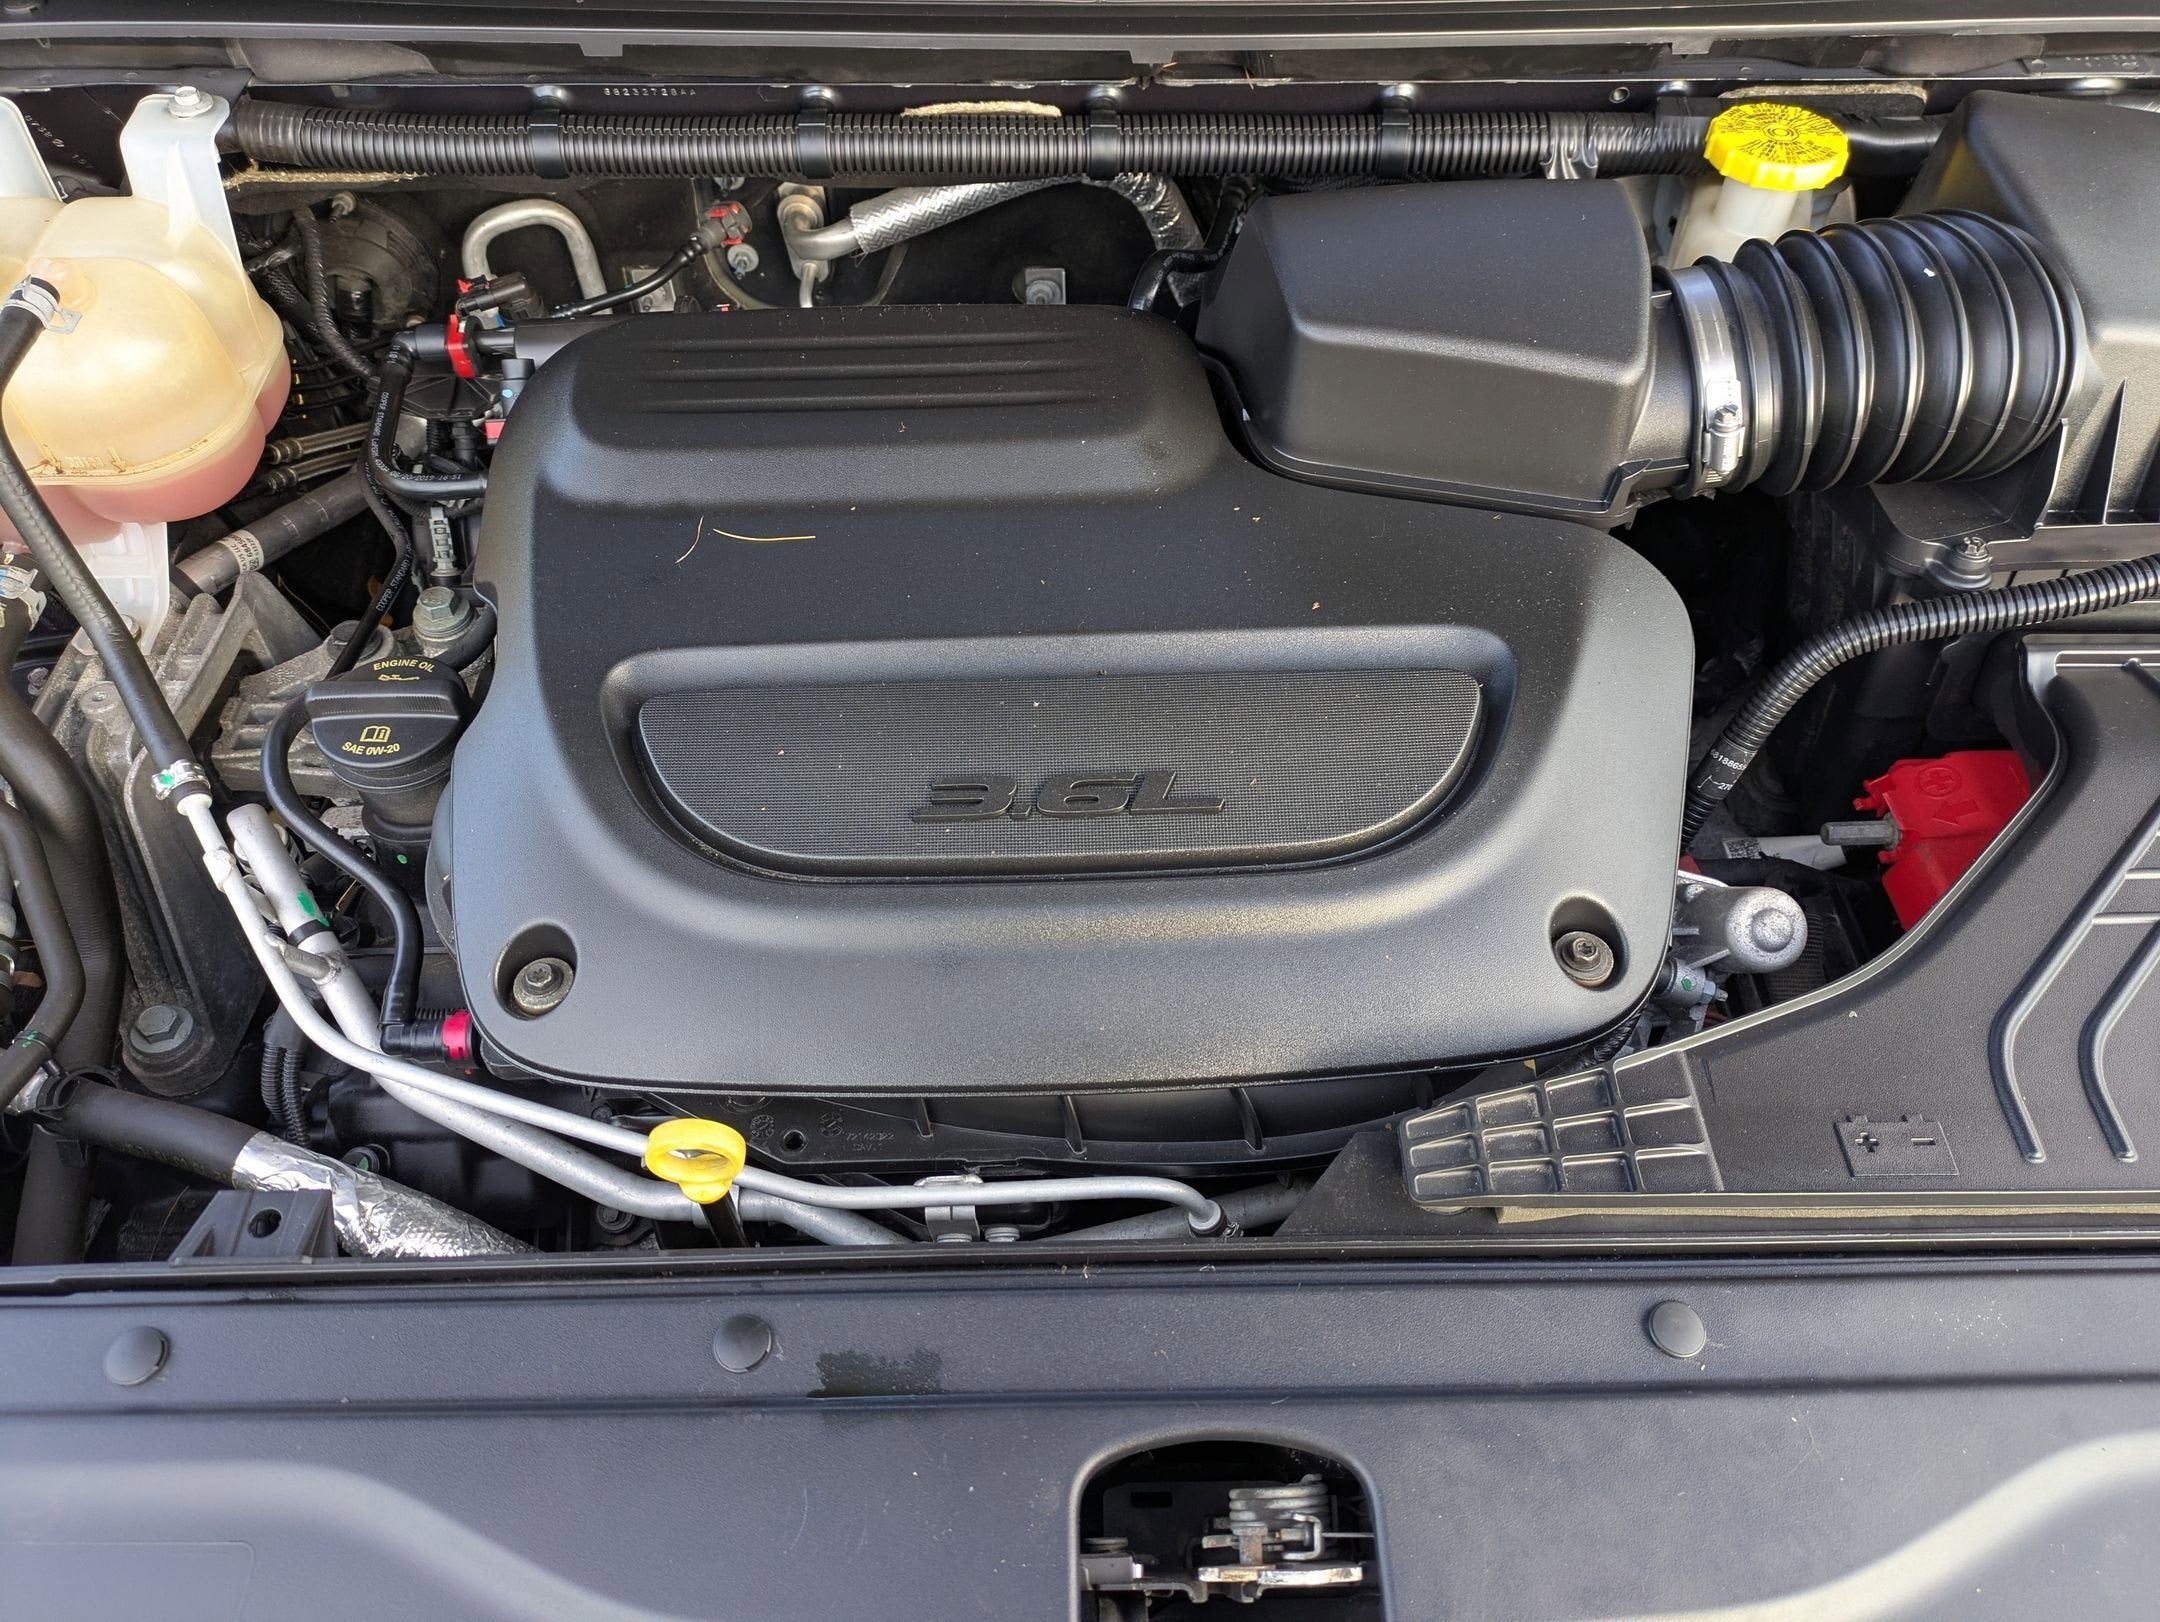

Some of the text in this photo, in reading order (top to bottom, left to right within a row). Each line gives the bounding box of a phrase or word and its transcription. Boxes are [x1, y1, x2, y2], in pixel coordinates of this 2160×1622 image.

[373, 659, 436, 673] ENGINE OIL
[342, 741, 401, 756] SAE 0W-20
[911, 770, 1225, 822] 3.6L
